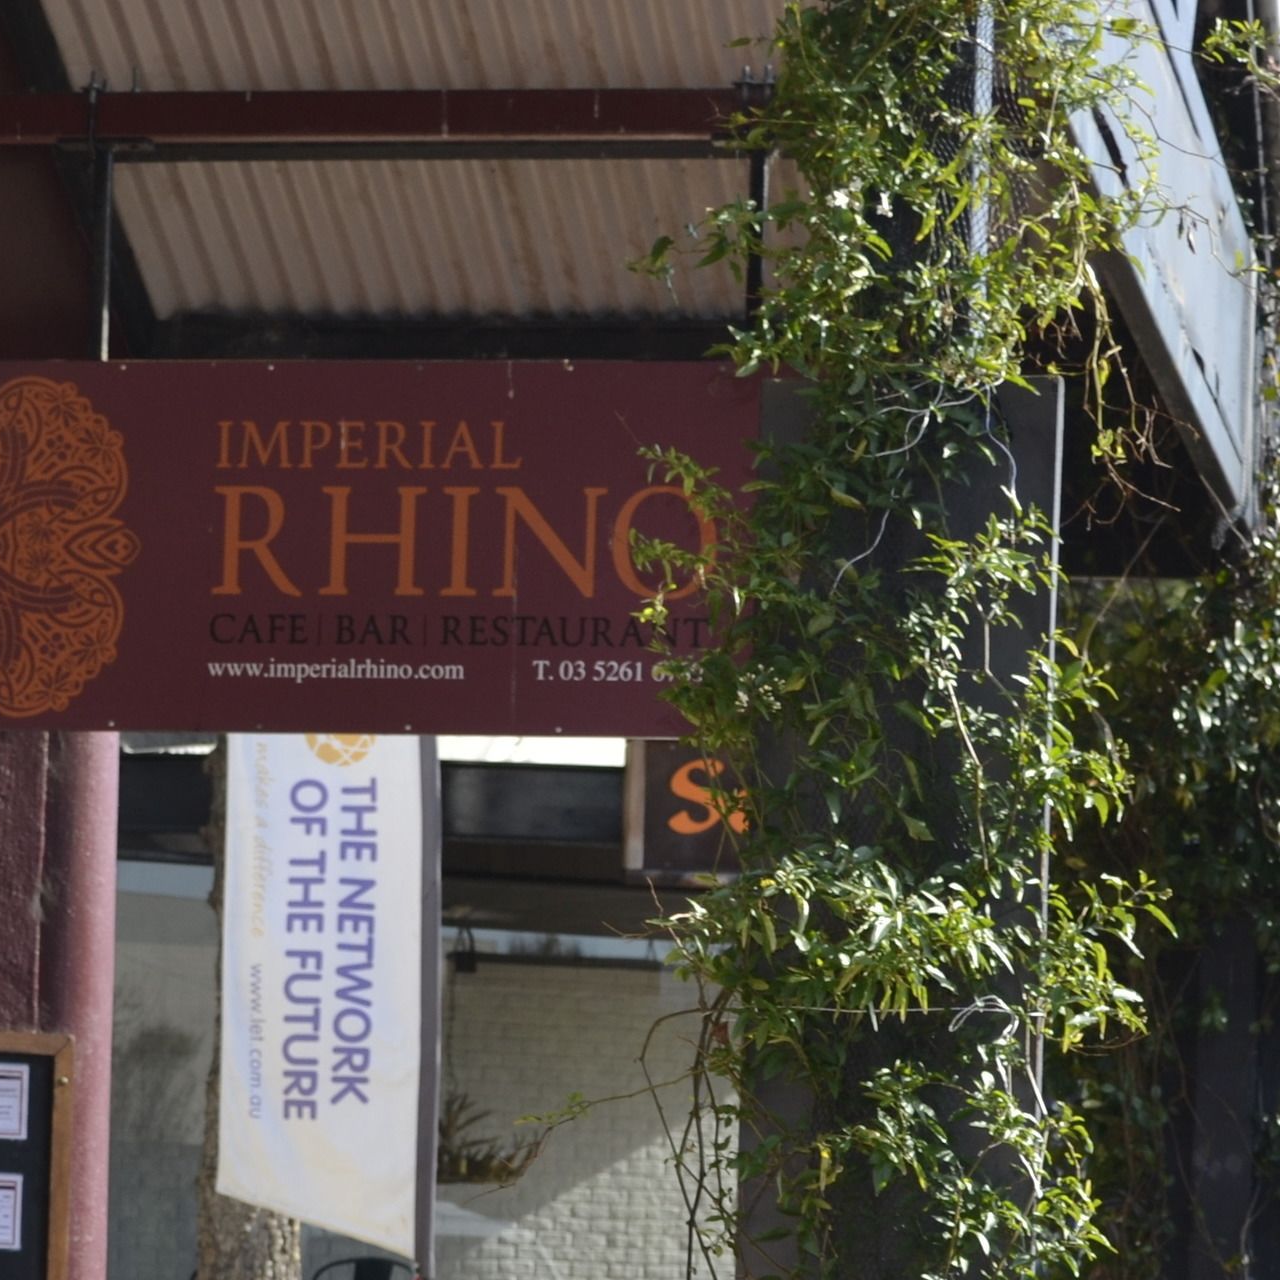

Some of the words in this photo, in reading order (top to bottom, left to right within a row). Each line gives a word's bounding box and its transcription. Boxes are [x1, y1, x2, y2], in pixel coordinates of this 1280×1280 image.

[216, 420, 523, 469] IMPERIAL
[211, 484, 719, 600] RHINO
[207, 657, 465, 684] www.imperialrhino.com
[533, 660, 554, 681] T.
[558, 660, 587, 682] 03
[592, 660, 643, 683] 5261
[209, 613, 308, 646] CAFE
[334, 615, 413, 646] BAR
[441, 614, 710, 649] RESTAURANT
[289, 778, 329, 838] OF
[339, 776, 377, 864] THE
[286, 849, 327, 935] THE
[330, 877, 376, 1105] NETWORK
[282, 948, 322, 1121] FUTURE
